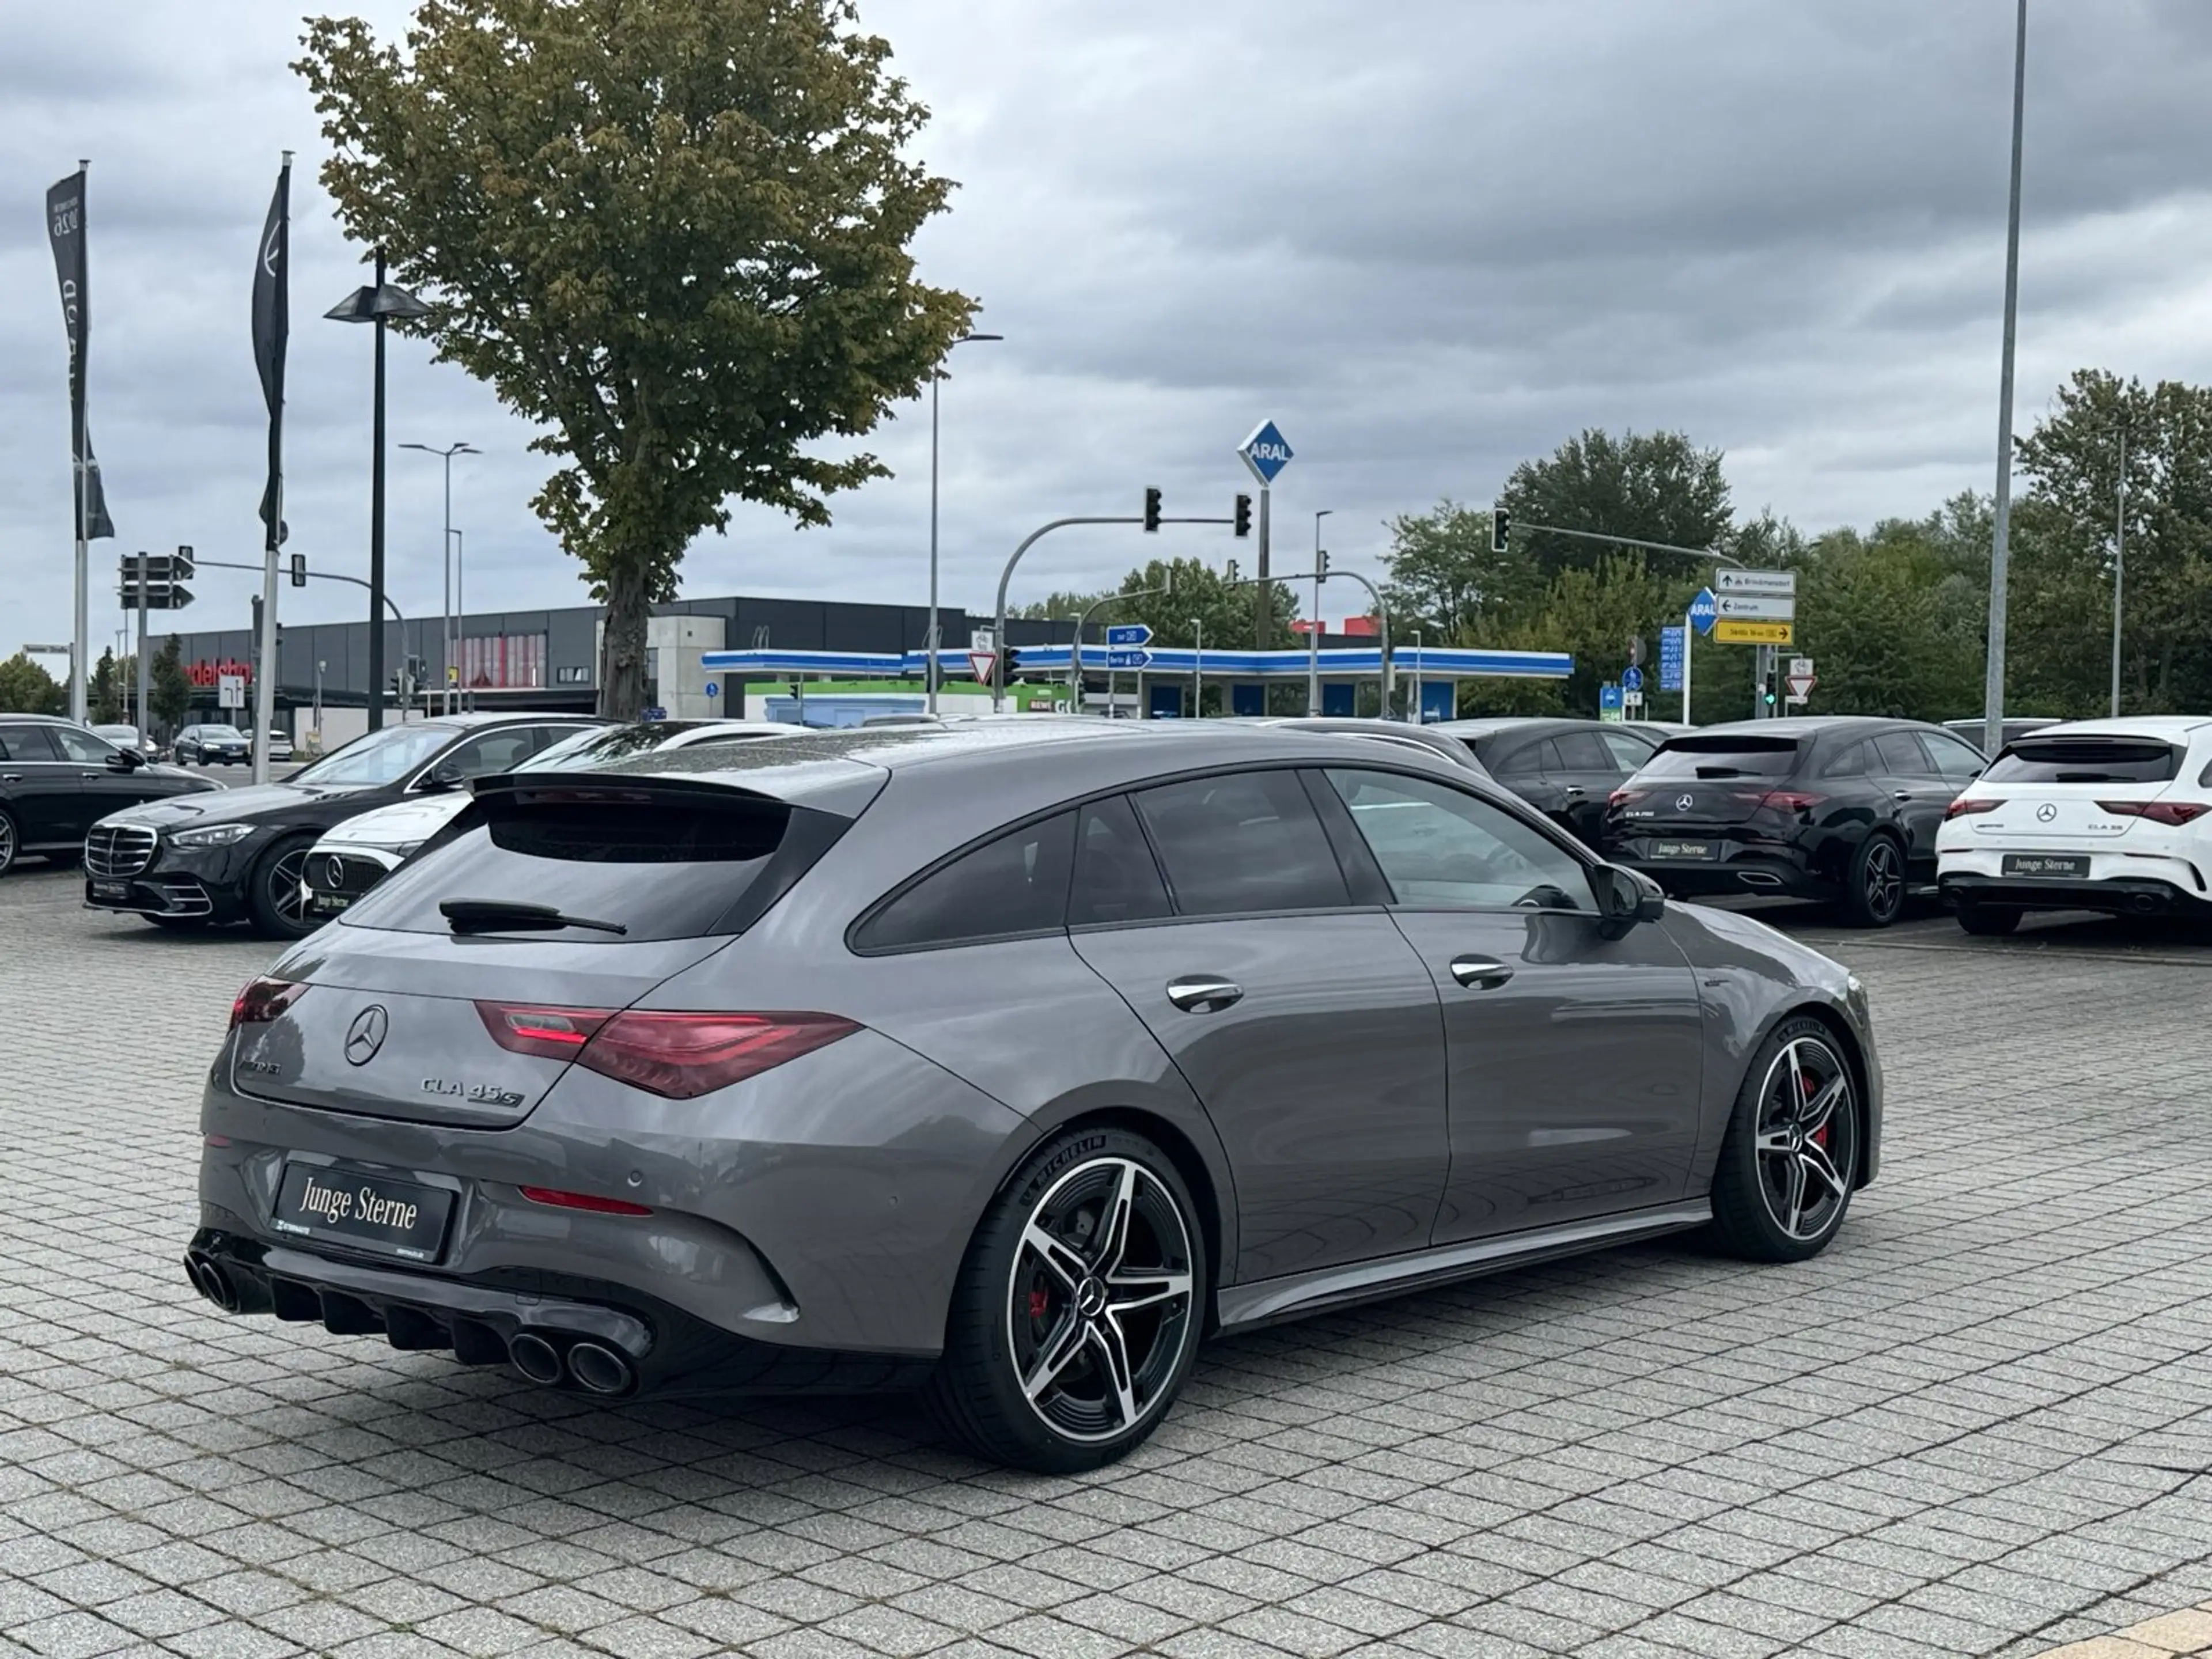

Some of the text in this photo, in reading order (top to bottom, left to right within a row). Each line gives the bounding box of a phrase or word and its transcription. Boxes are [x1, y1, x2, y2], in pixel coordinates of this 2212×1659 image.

[1251, 442, 1291, 461] ARAL
[1691, 603, 1715, 616] ARAL
[1681, 843, 1707, 854] Sterne
[2015, 858, 2075, 872] Junge Sterne
[421, 1078, 464, 1096] CLA
[1035, 1135, 1107, 1189] MICHELIN
[299, 1176, 418, 1230] Junge Sterne
